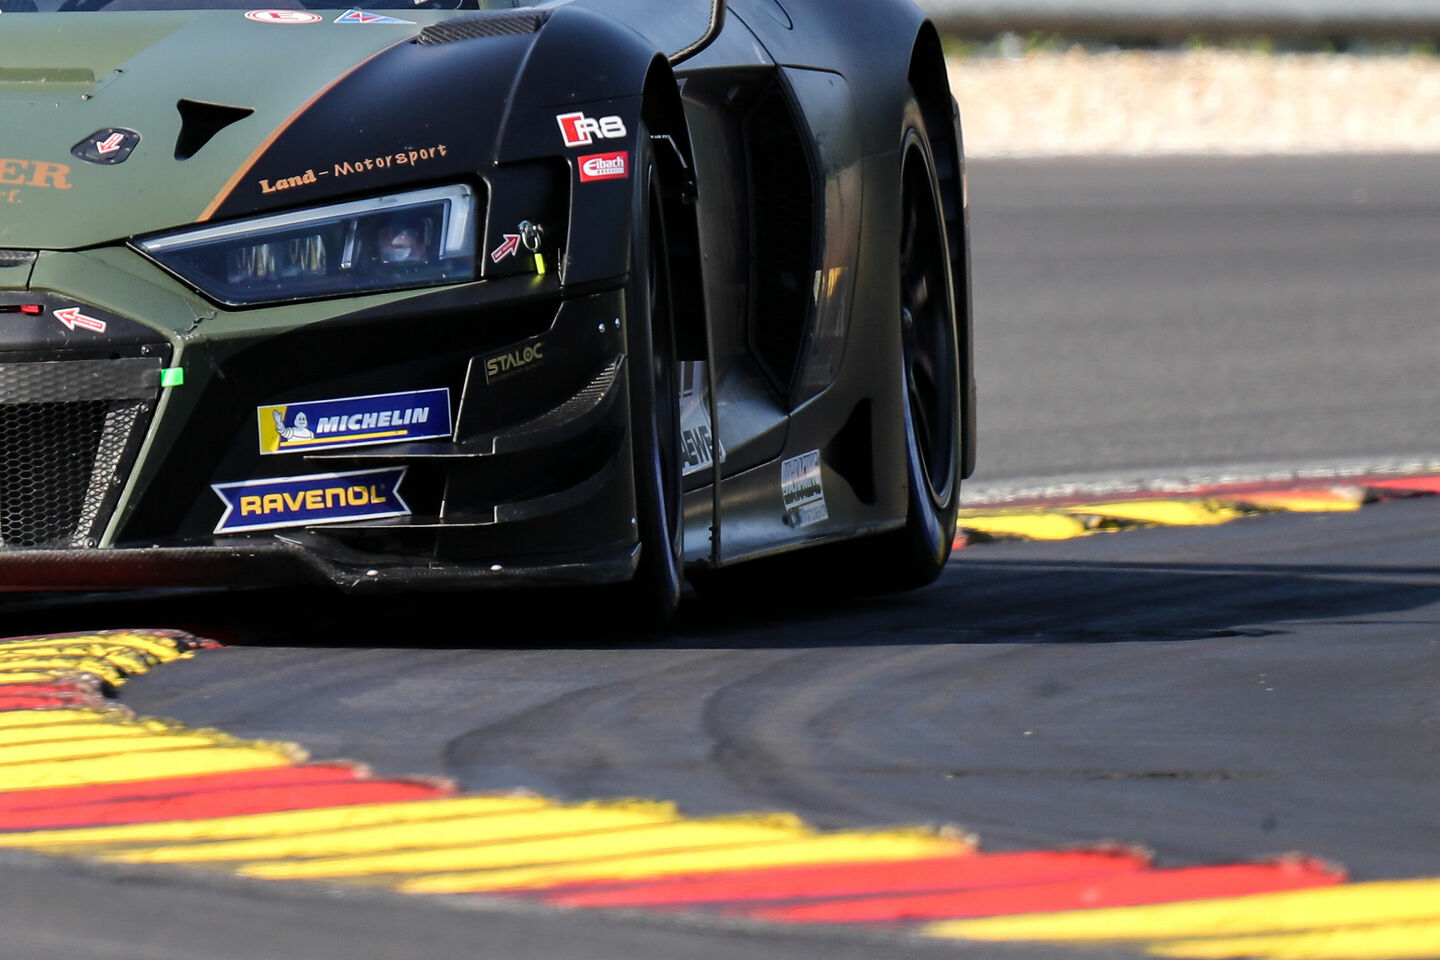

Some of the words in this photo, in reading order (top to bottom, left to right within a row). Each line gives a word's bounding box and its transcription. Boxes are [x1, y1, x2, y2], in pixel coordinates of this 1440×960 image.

[563, 113, 627, 144] R8
[487, 342, 544, 376] STALOC
[316, 407, 430, 434] MICHELIN
[240, 485, 387, 516] RAVENOL
